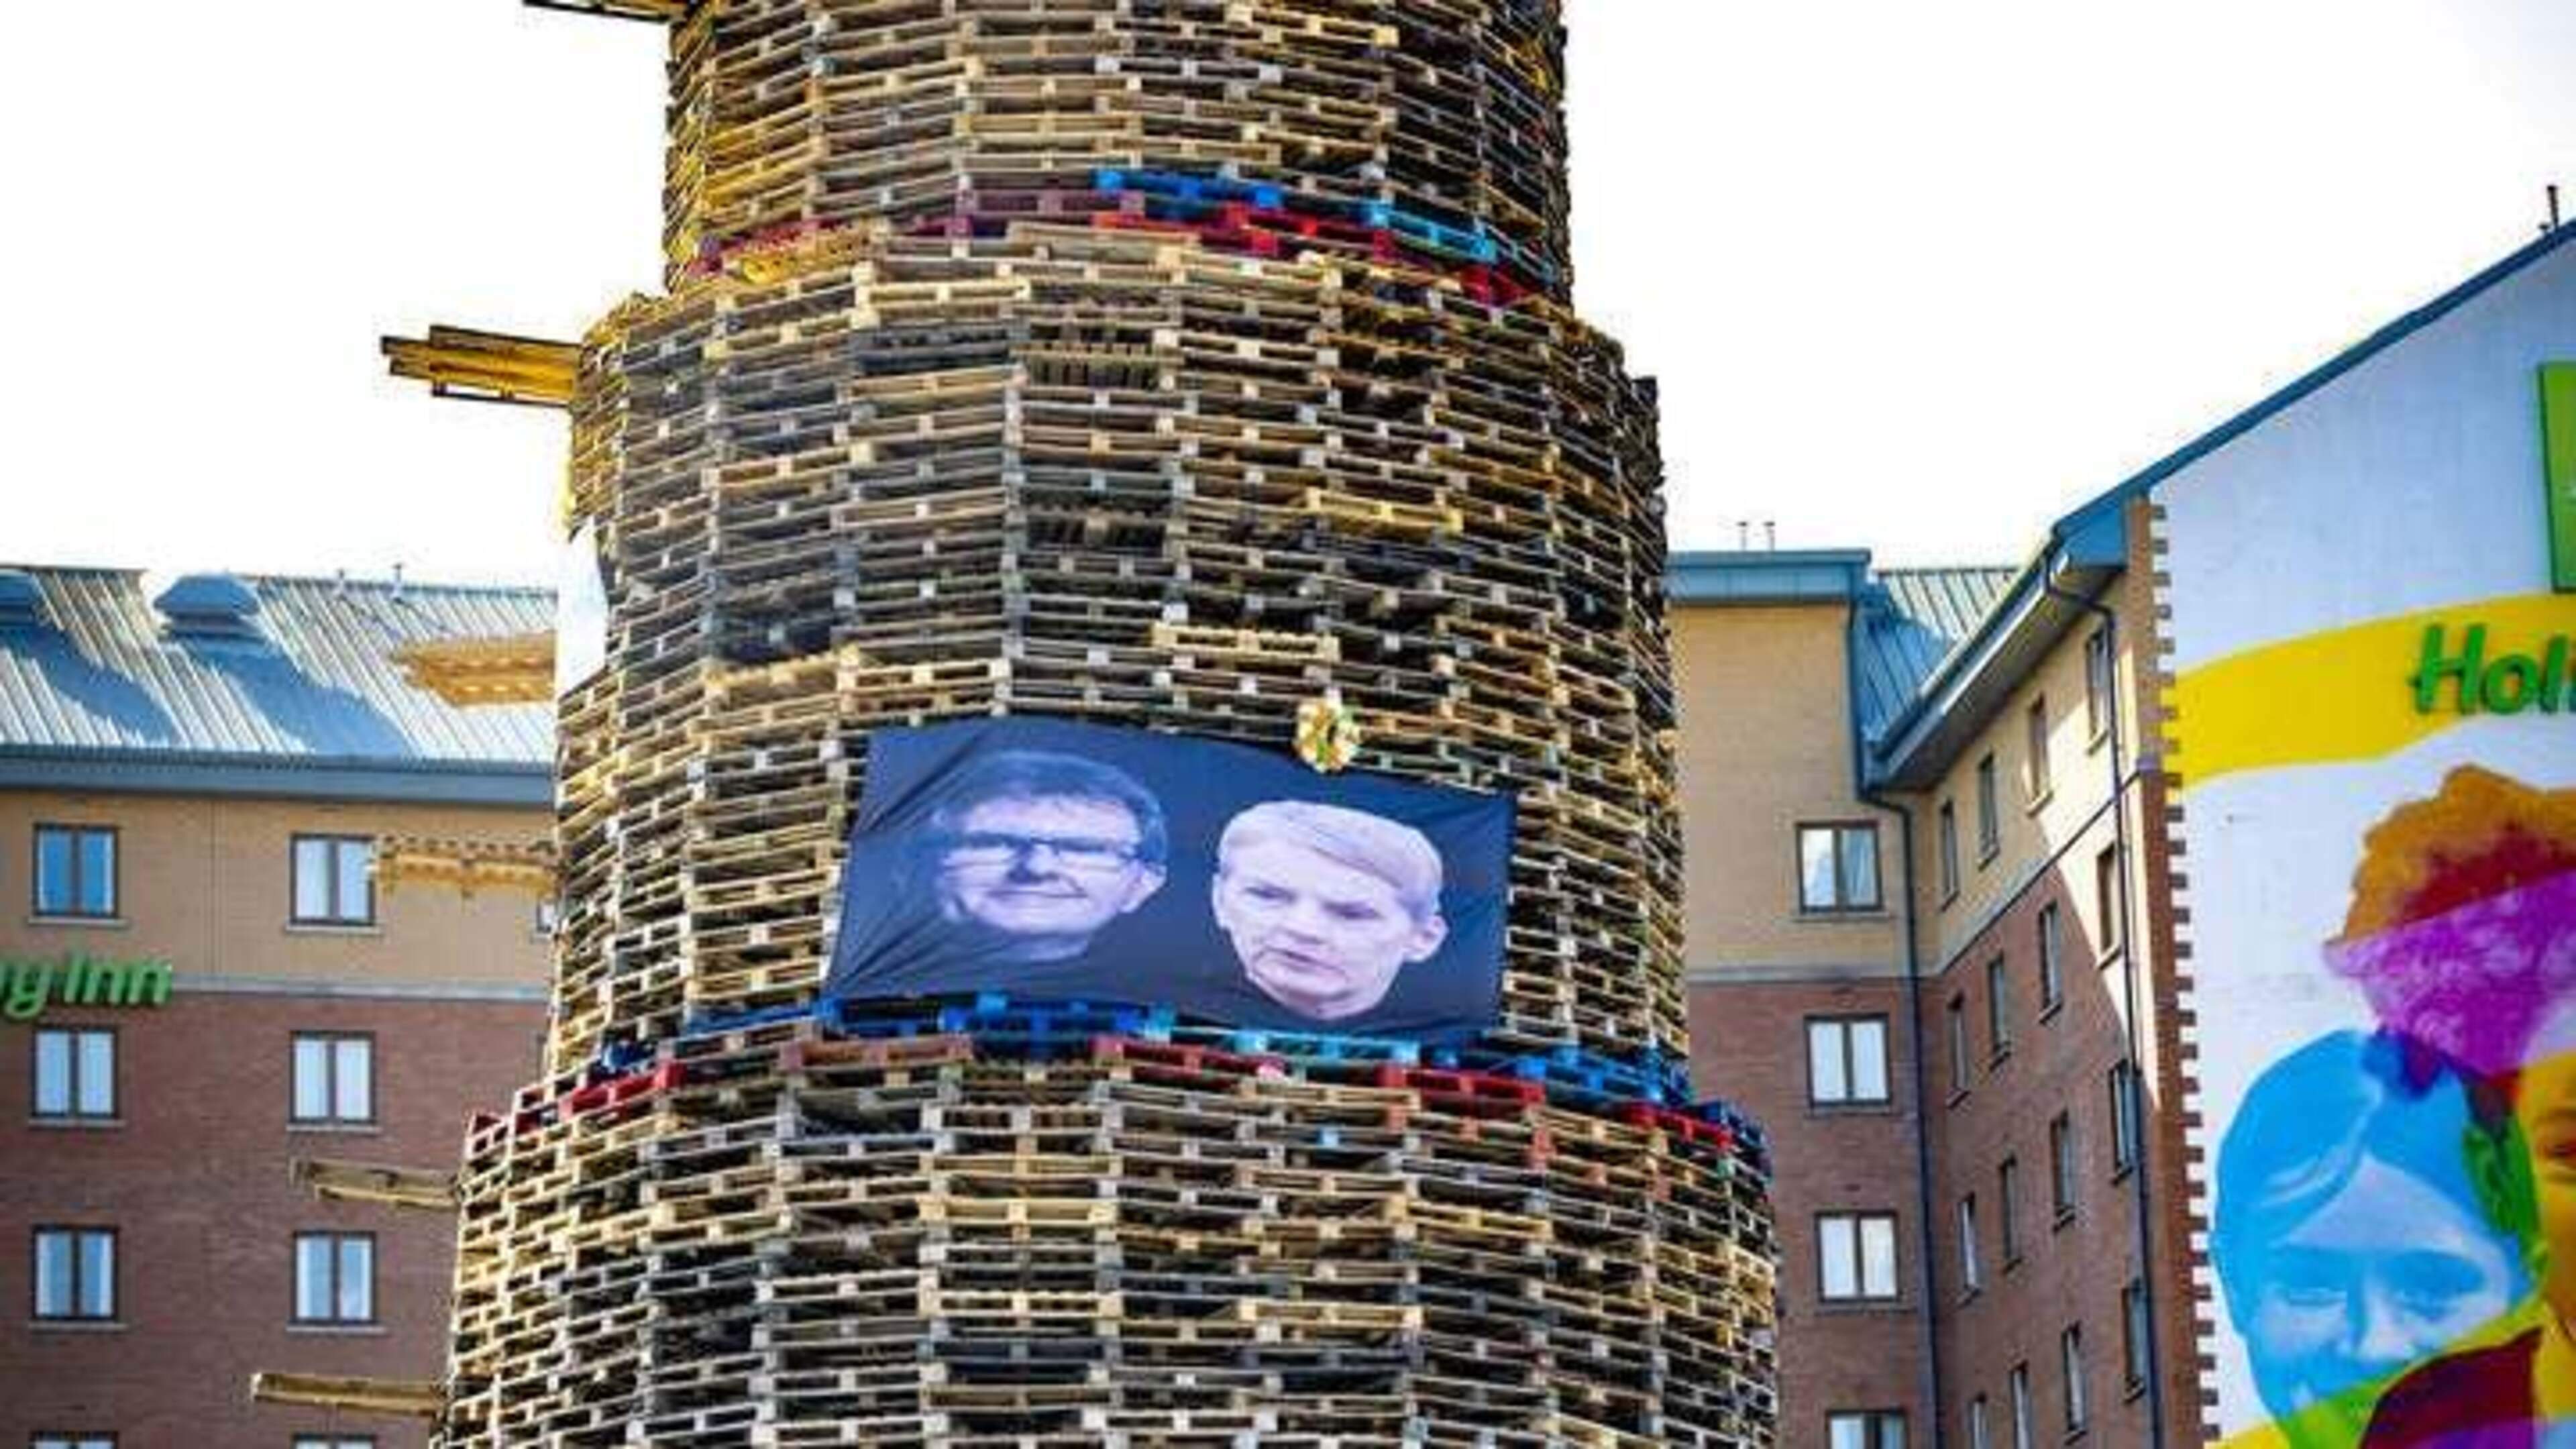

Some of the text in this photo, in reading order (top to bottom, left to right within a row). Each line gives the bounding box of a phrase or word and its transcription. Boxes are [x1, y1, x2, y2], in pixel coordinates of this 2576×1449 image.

[2408, 623, 2576, 715] Hol
[0, 950, 172, 1020] y Inn
